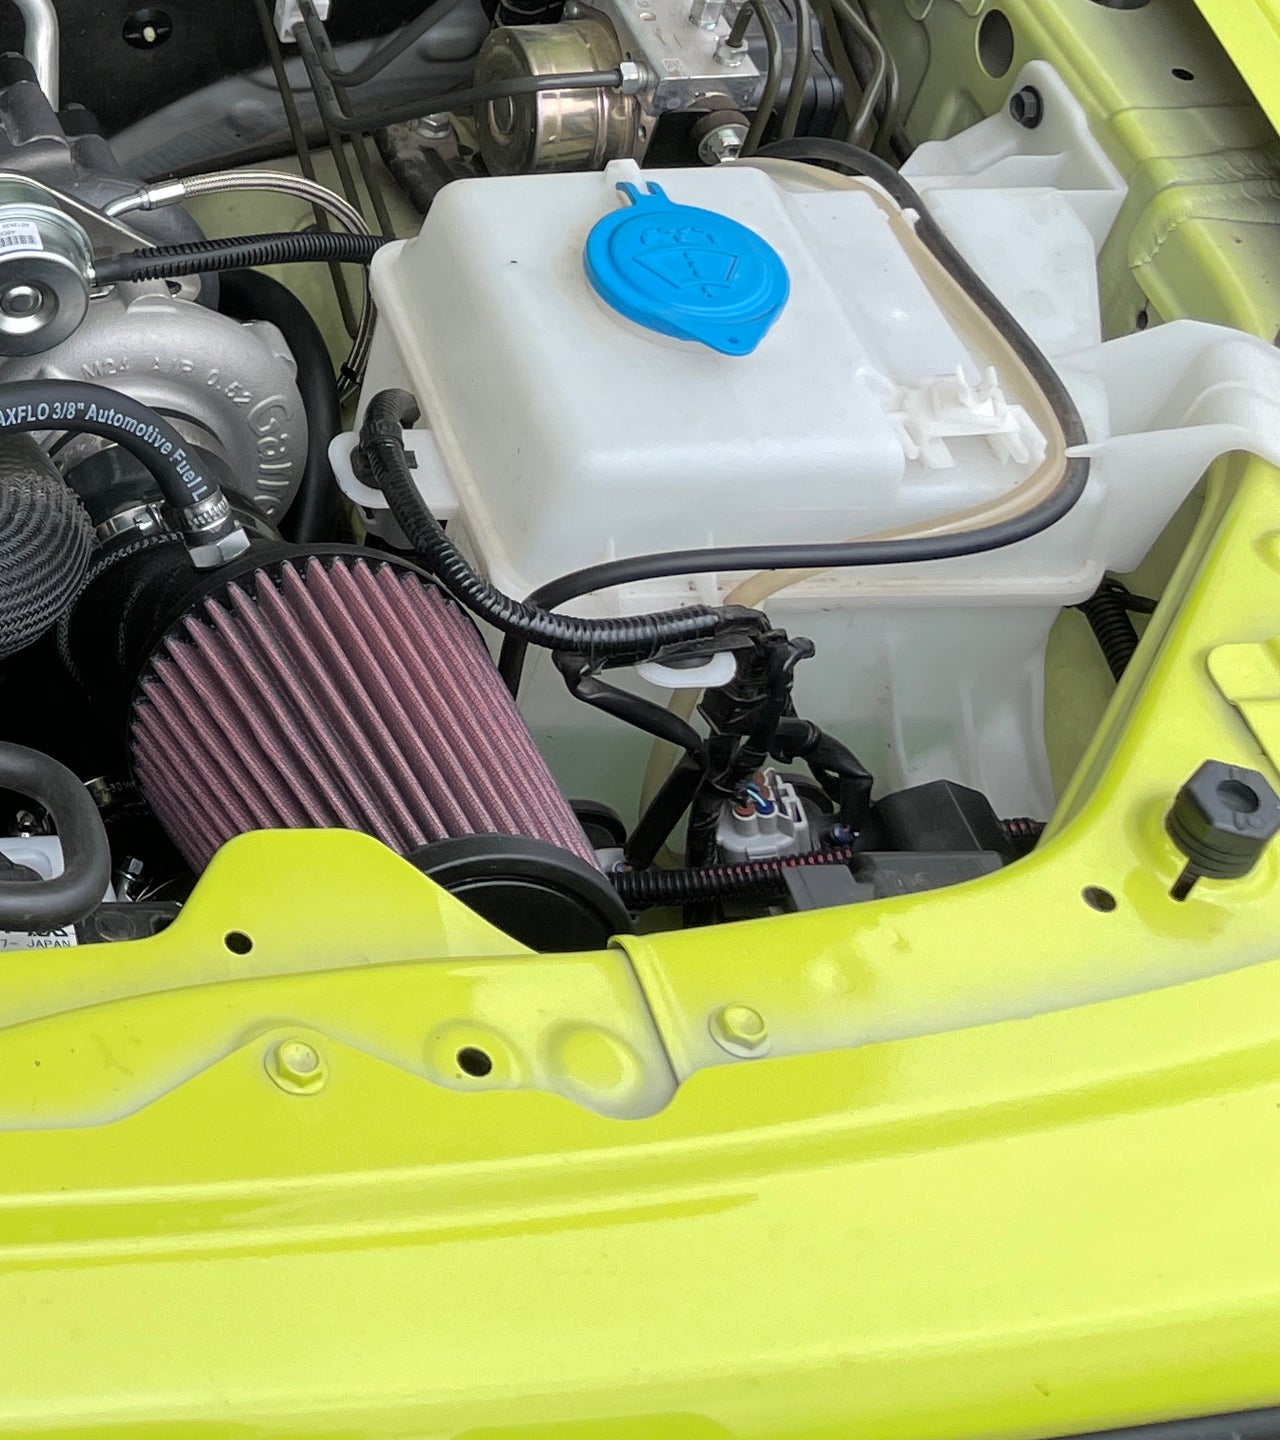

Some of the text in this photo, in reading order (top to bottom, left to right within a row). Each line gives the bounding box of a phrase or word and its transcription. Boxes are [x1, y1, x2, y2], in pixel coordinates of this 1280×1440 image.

[52, 400, 85, 420] 3/8"
[84, 403, 173, 455] Automotive
[169, 448, 204, 488] Fuel
[27, 940, 71, 949] JAPAN
